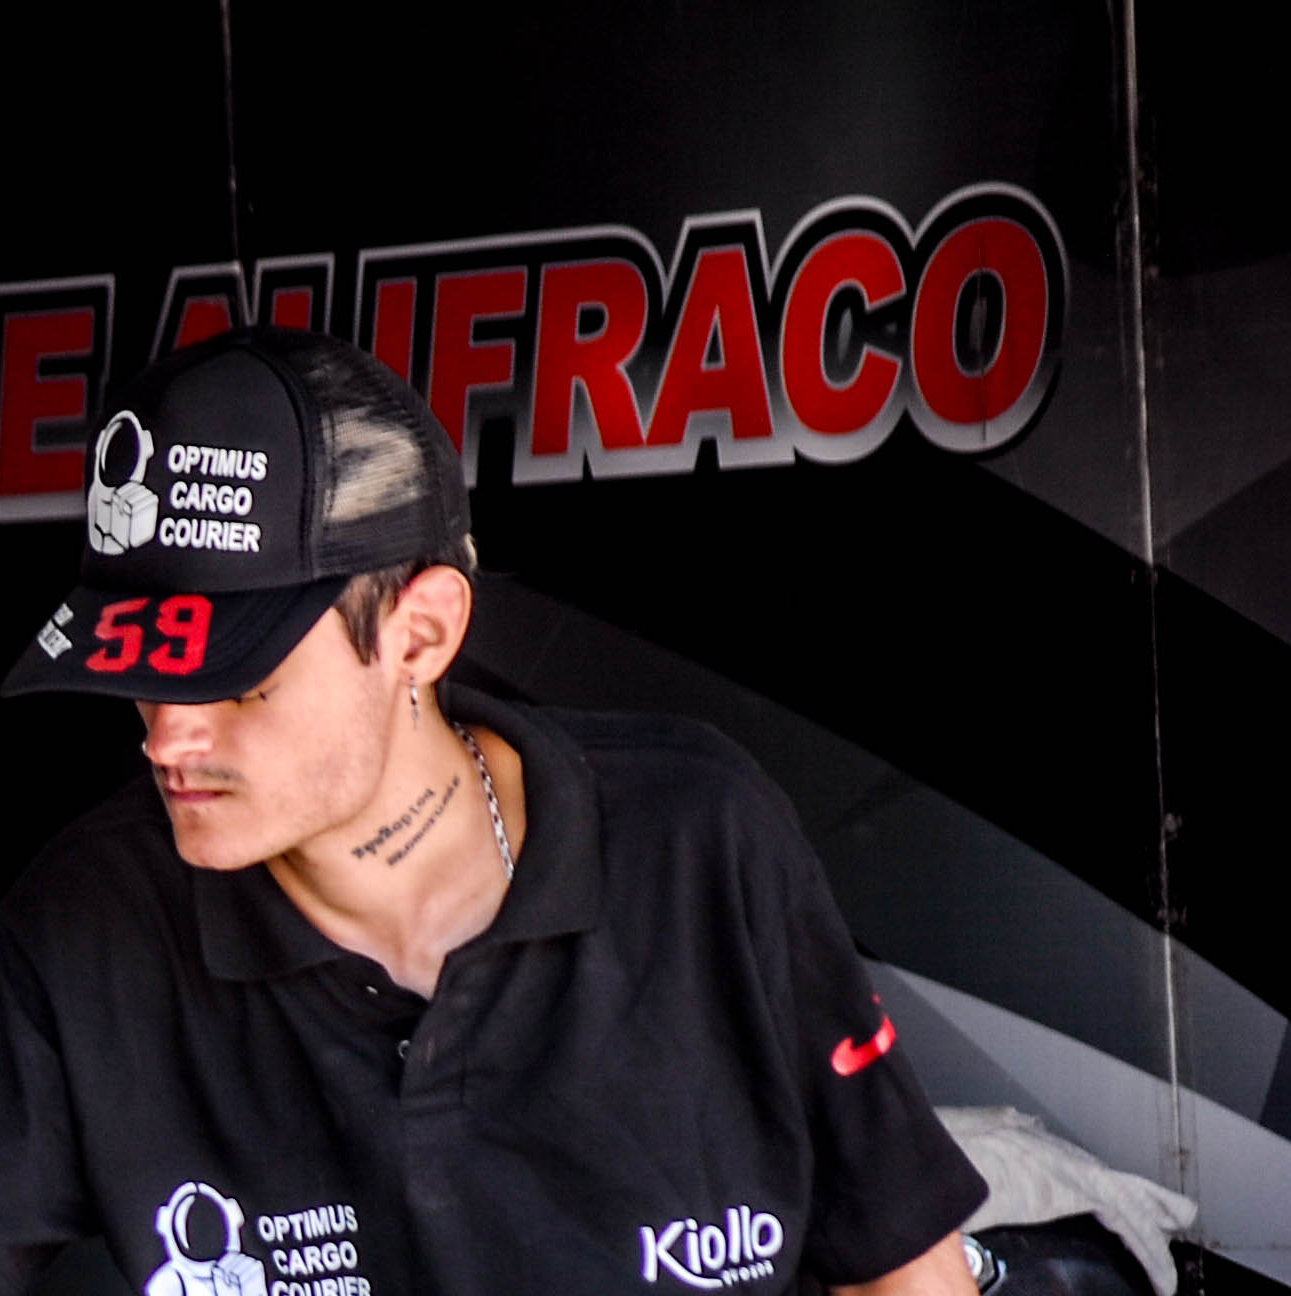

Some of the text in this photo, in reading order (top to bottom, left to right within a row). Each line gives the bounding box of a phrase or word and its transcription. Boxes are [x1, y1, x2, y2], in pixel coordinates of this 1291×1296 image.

[167, 444, 268, 481] OPTIMUS
[169, 480, 254, 516] CARGO
[159, 517, 261, 553] COURIER
[84, 594, 215, 677] 59
[256, 1202, 360, 1243] OPTIMUS
[271, 1239, 360, 1277] CARGO
[639, 1203, 785, 1289] Kiollo
